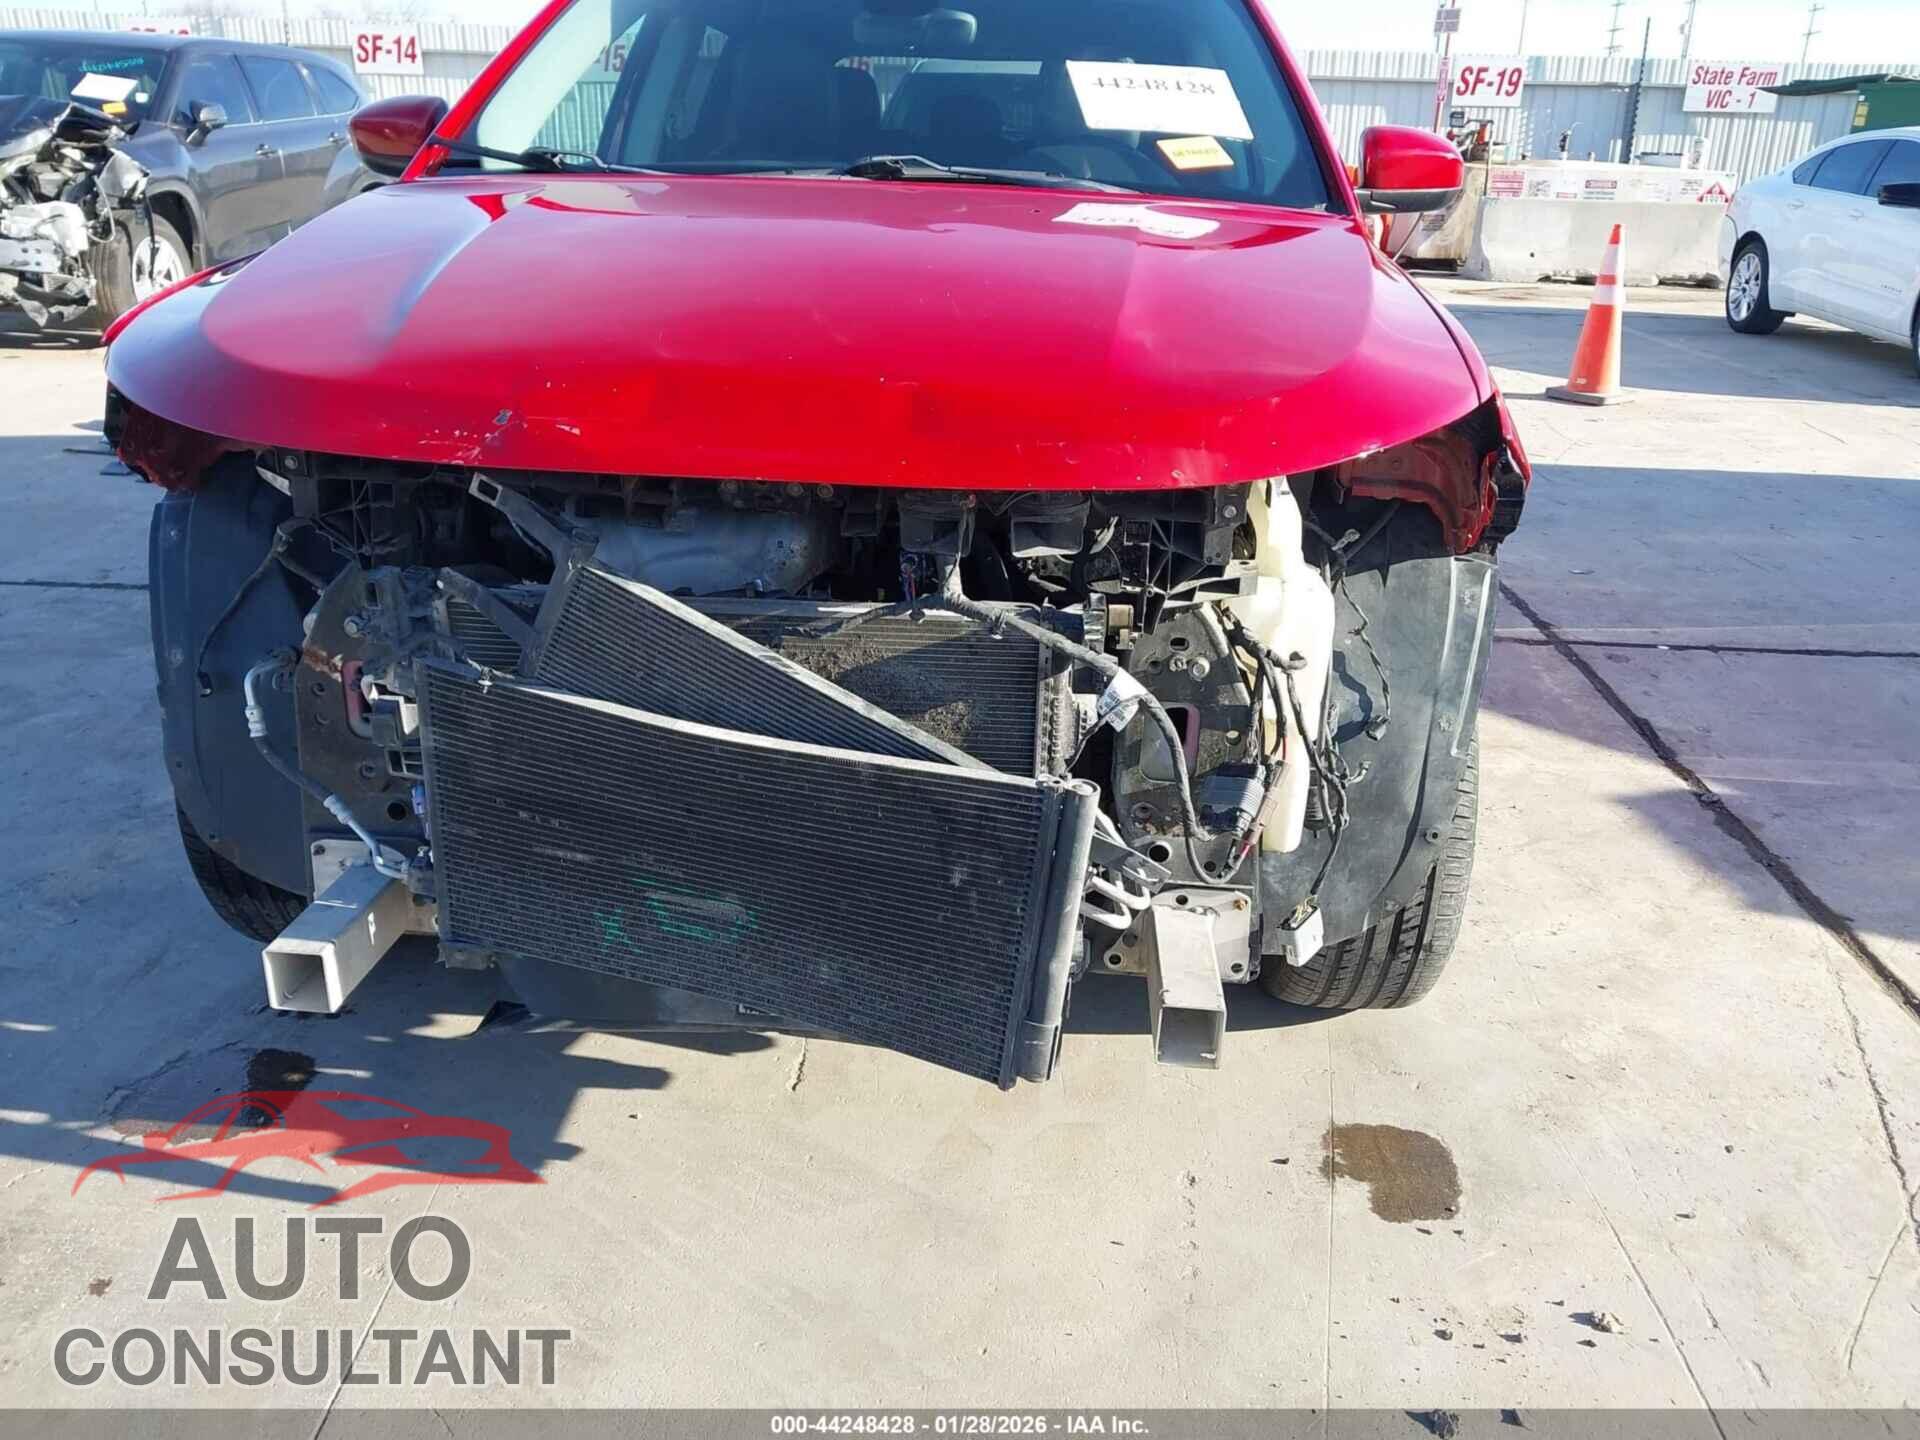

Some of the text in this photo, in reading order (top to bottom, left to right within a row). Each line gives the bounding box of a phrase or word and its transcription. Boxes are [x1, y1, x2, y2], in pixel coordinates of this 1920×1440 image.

[357, 33, 417, 64] SF-14
[1456, 66, 1522, 96] SF-19
[1692, 65, 1777, 86] State Farm
[1706, 90, 1732, 109] VIC
[1748, 91, 1757, 109] 1
